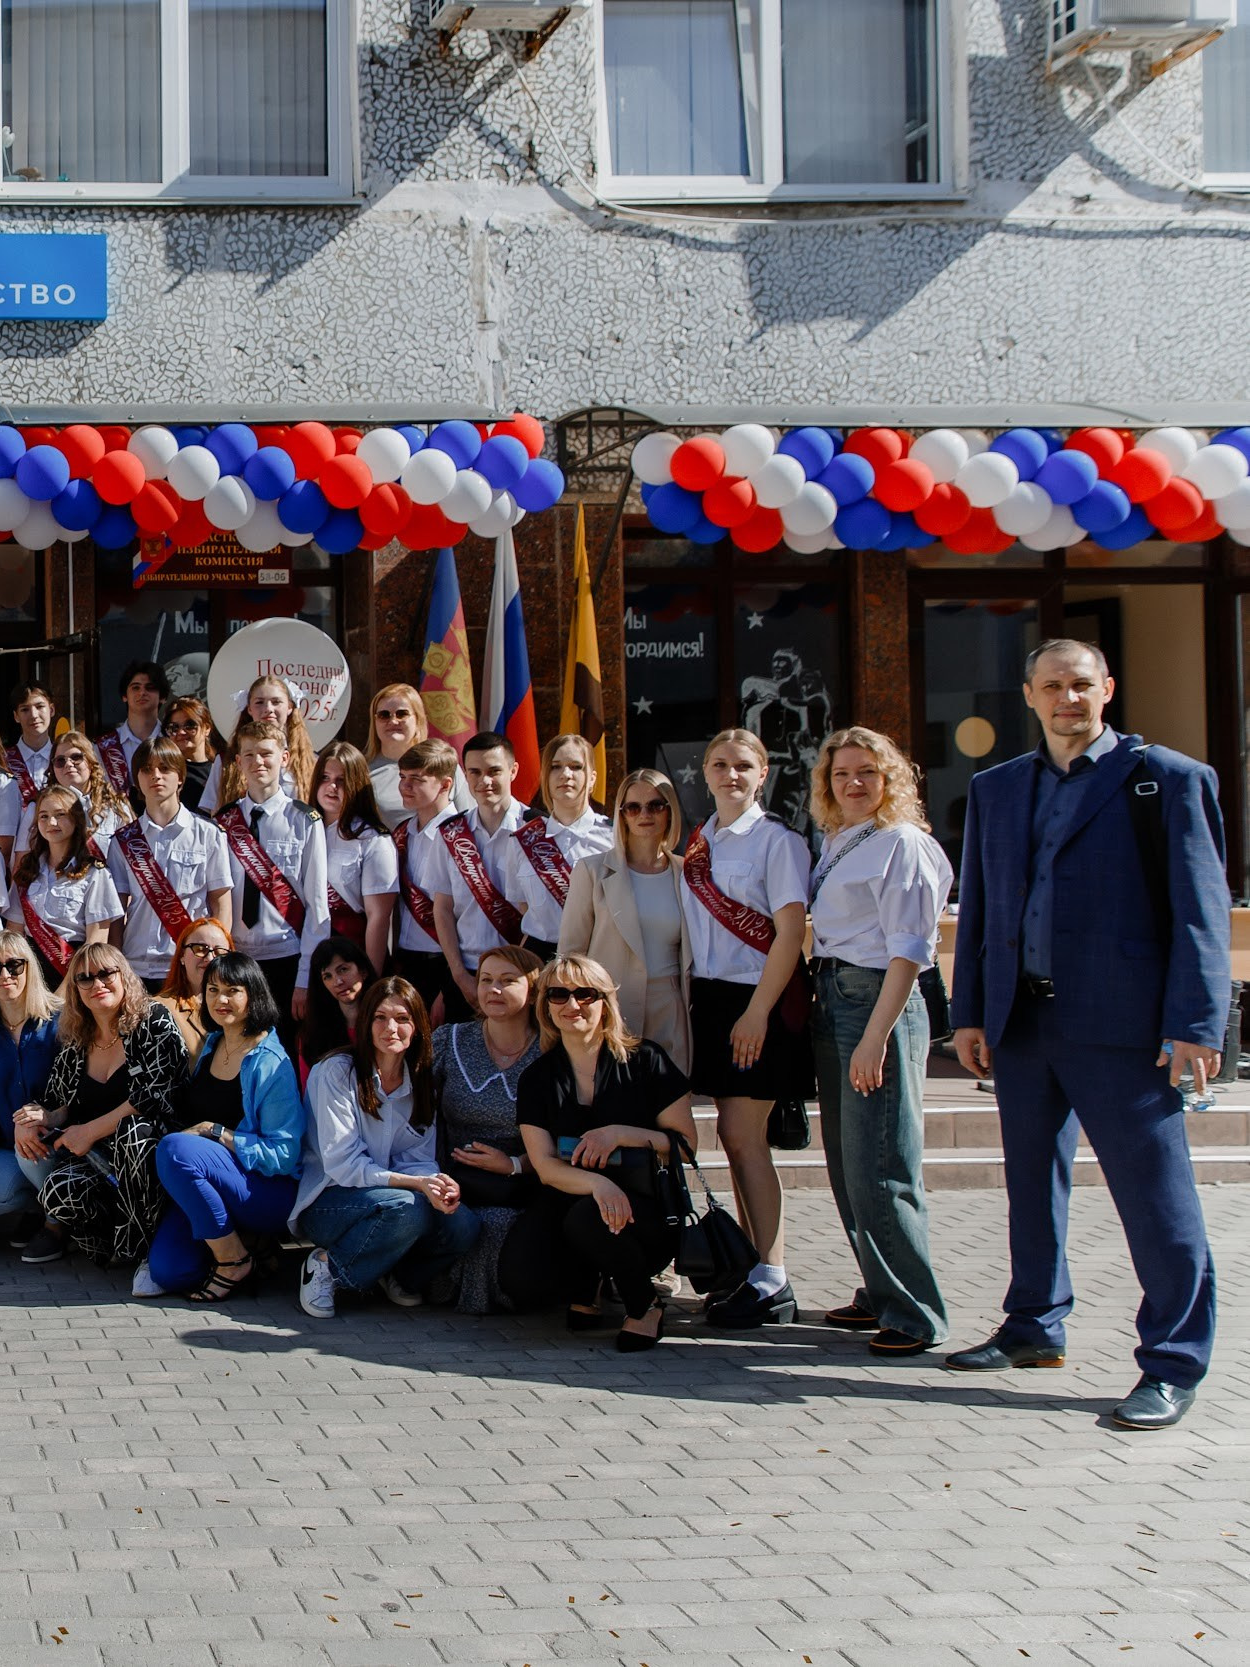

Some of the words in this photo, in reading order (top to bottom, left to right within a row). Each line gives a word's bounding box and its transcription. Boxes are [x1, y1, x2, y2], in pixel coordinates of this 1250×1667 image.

[194, 556, 264, 567] КОМИССИЯ
[139, 573, 209, 582] ИЗБИРАТЕЛЬНОГО
[211, 573, 246, 582] УЧАСТКА
[174, 610, 209, 635] Мы
[256, 658, 348, 683] Последний
[299, 698, 337, 722] 025г.
[126, 838, 164, 898] Выпускник
